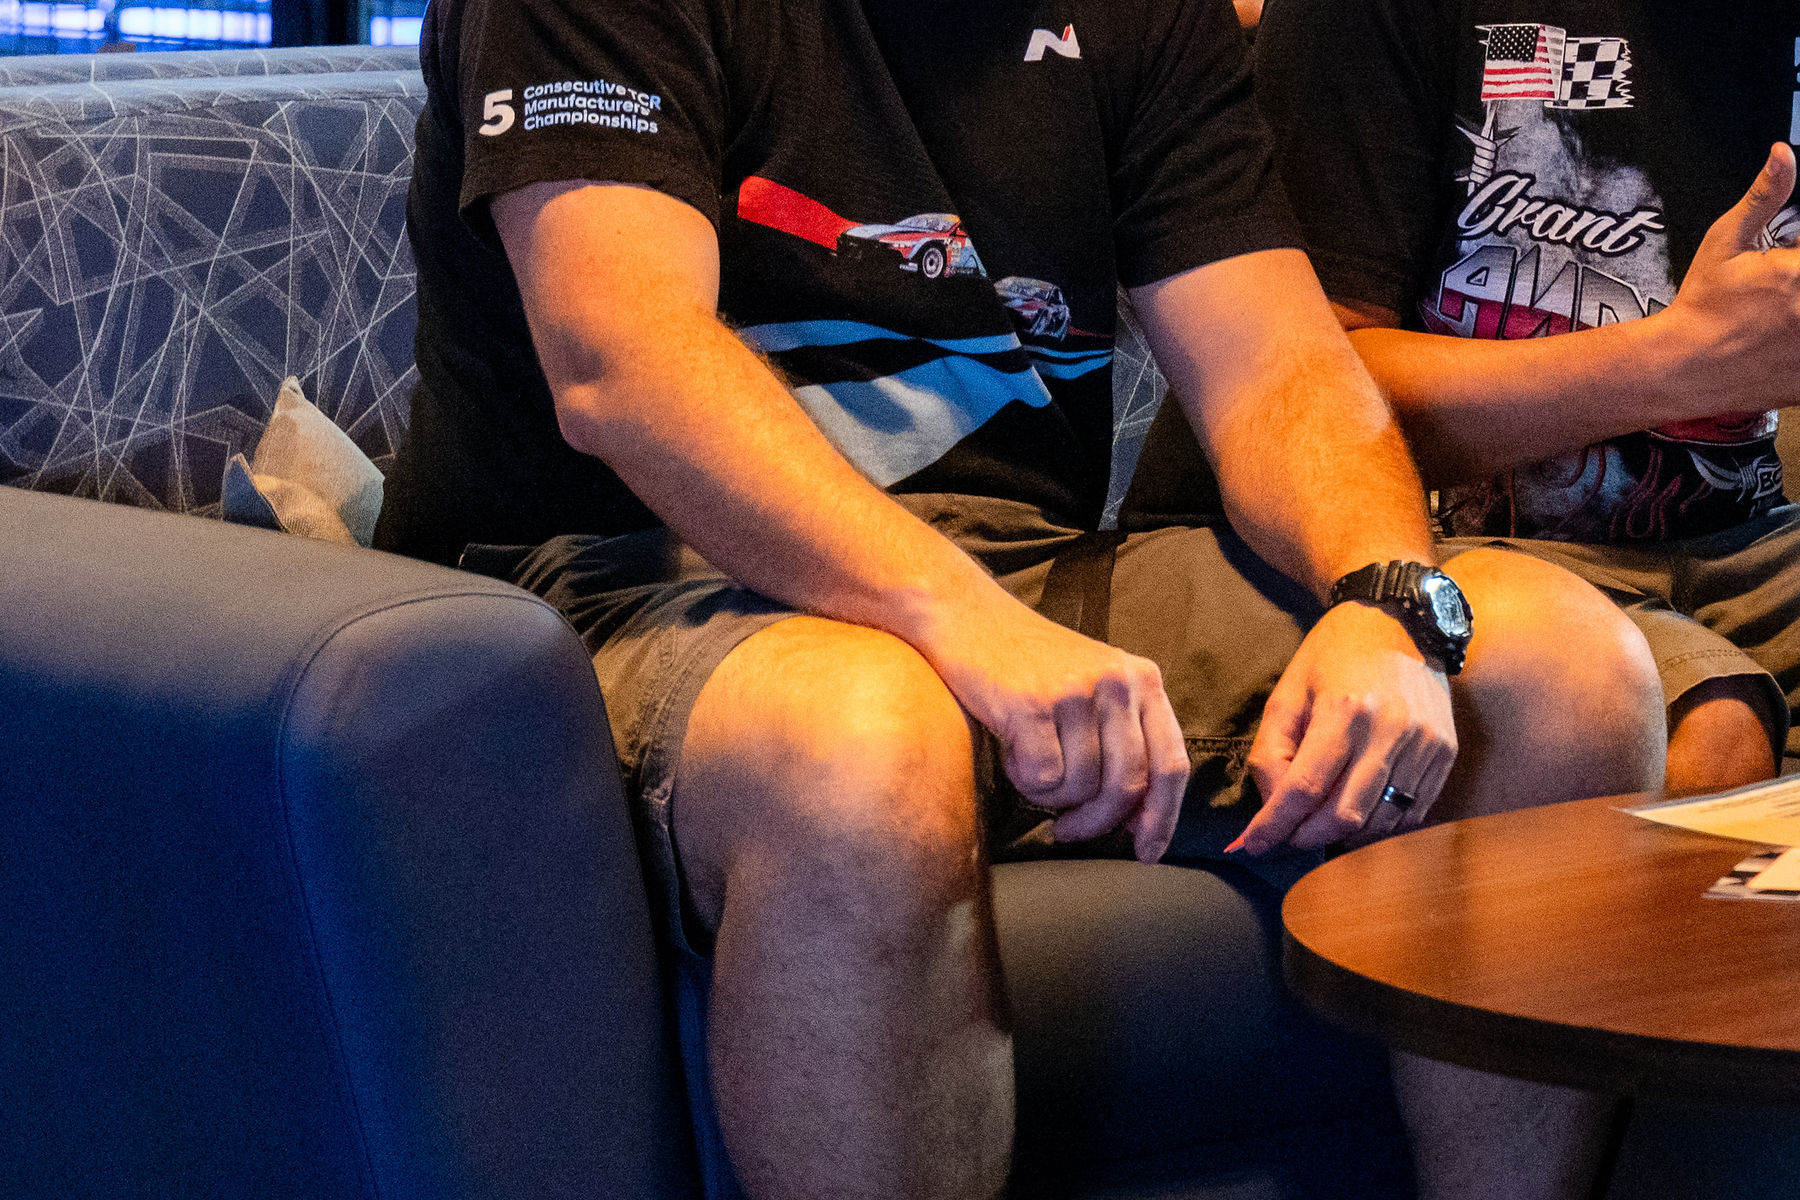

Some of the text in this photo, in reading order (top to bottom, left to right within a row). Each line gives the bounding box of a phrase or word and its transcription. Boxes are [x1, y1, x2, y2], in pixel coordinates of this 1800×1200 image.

[478, 89, 516, 136] 5
[523, 79, 662, 111] Consecutive TCR
[523, 109, 659, 134] Championships
[1456, 173, 1665, 254] Grant
[1438, 244, 1673, 341] AND
